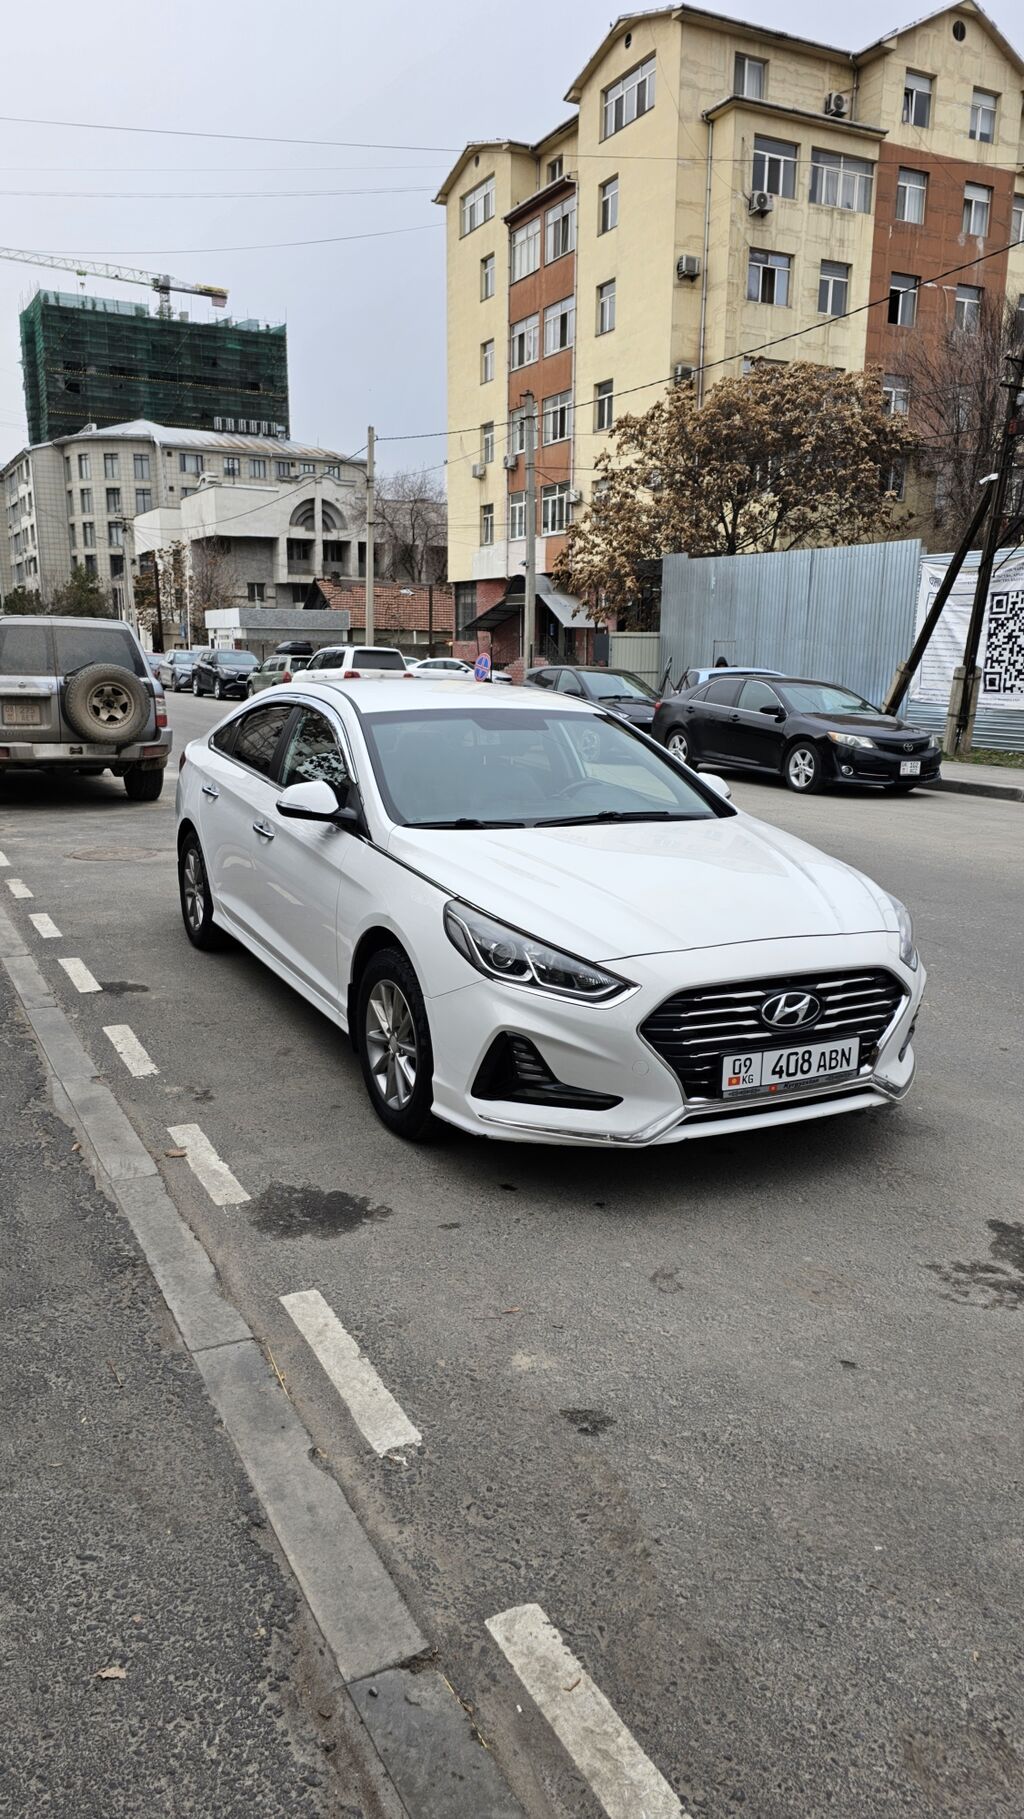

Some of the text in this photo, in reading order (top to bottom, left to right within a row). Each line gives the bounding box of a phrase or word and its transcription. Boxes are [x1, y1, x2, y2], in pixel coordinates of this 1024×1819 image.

[732, 1047, 852, 1079] 09 408 ABN
[742, 1075, 754, 1085] KG
